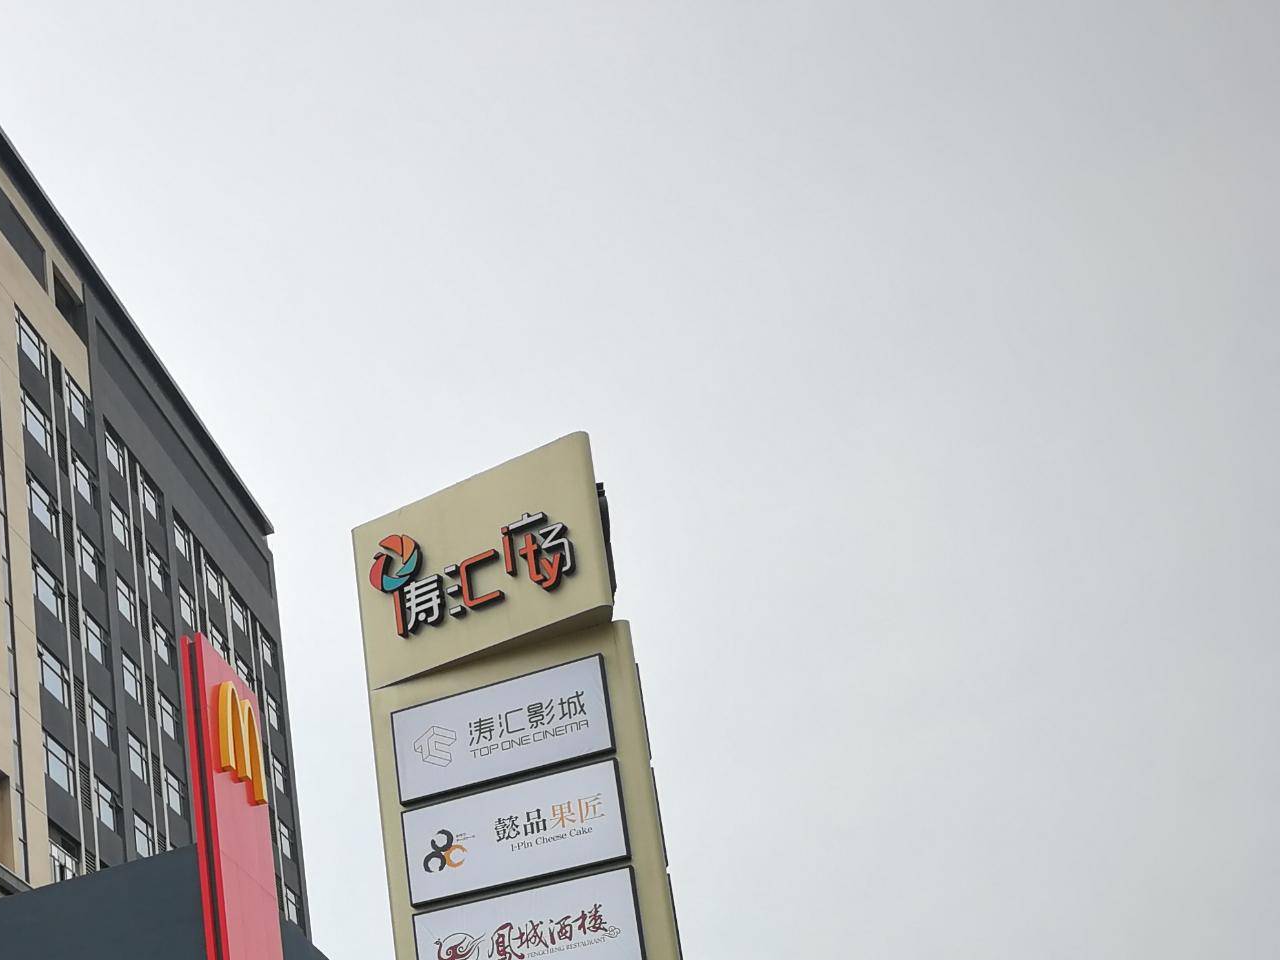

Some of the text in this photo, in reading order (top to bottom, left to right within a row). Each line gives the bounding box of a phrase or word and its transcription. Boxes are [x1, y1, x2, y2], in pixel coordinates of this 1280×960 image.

[469, 690, 587, 747] 涛汇影城
[470, 719, 589, 758] TOP ONE CINEMA
[494, 792, 606, 843] 懿品果匠
[535, 832, 568, 846] Cheese
[570, 825, 594, 837] Cake
